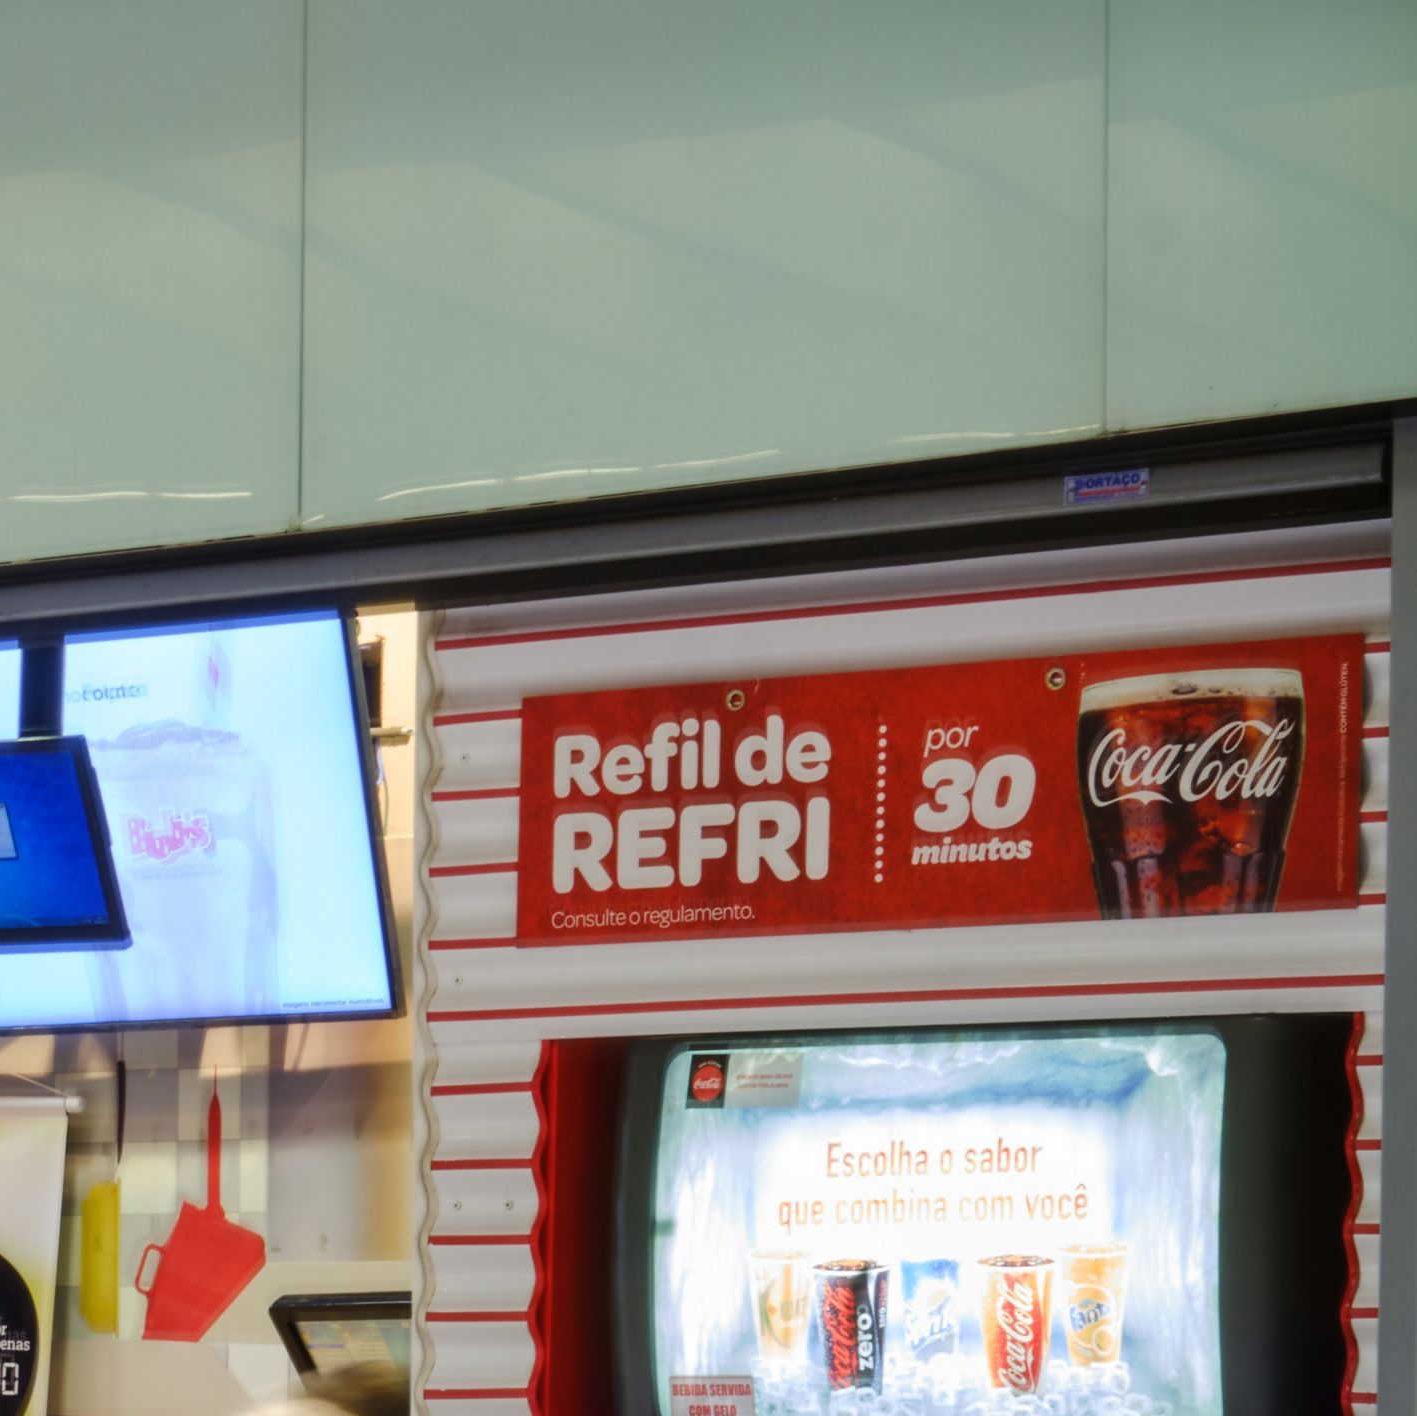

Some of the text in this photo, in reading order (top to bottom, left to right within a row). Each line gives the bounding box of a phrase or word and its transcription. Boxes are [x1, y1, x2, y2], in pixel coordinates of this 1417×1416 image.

[553, 714, 832, 798] Refil de
[923, 723, 979, 758] por
[1088, 717, 1296, 808] Coca-Cola
[913, 753, 1037, 833] 30
[552, 797, 831, 894] REFRI
[911, 836, 1033, 865] minutos
[551, 903, 756, 929] Consulte o regulamento.
[827, 1137, 1044, 1178] Escolha o sabor
[778, 1182, 1089, 1237] que combina com você
[856, 1312, 875, 1372] zero
[995, 1273, 1034, 1397] Coca-Cola
[672, 1383, 752, 1396] BEBIDA SERVIDA
[689, 1404, 737, 1416] COM GELO
